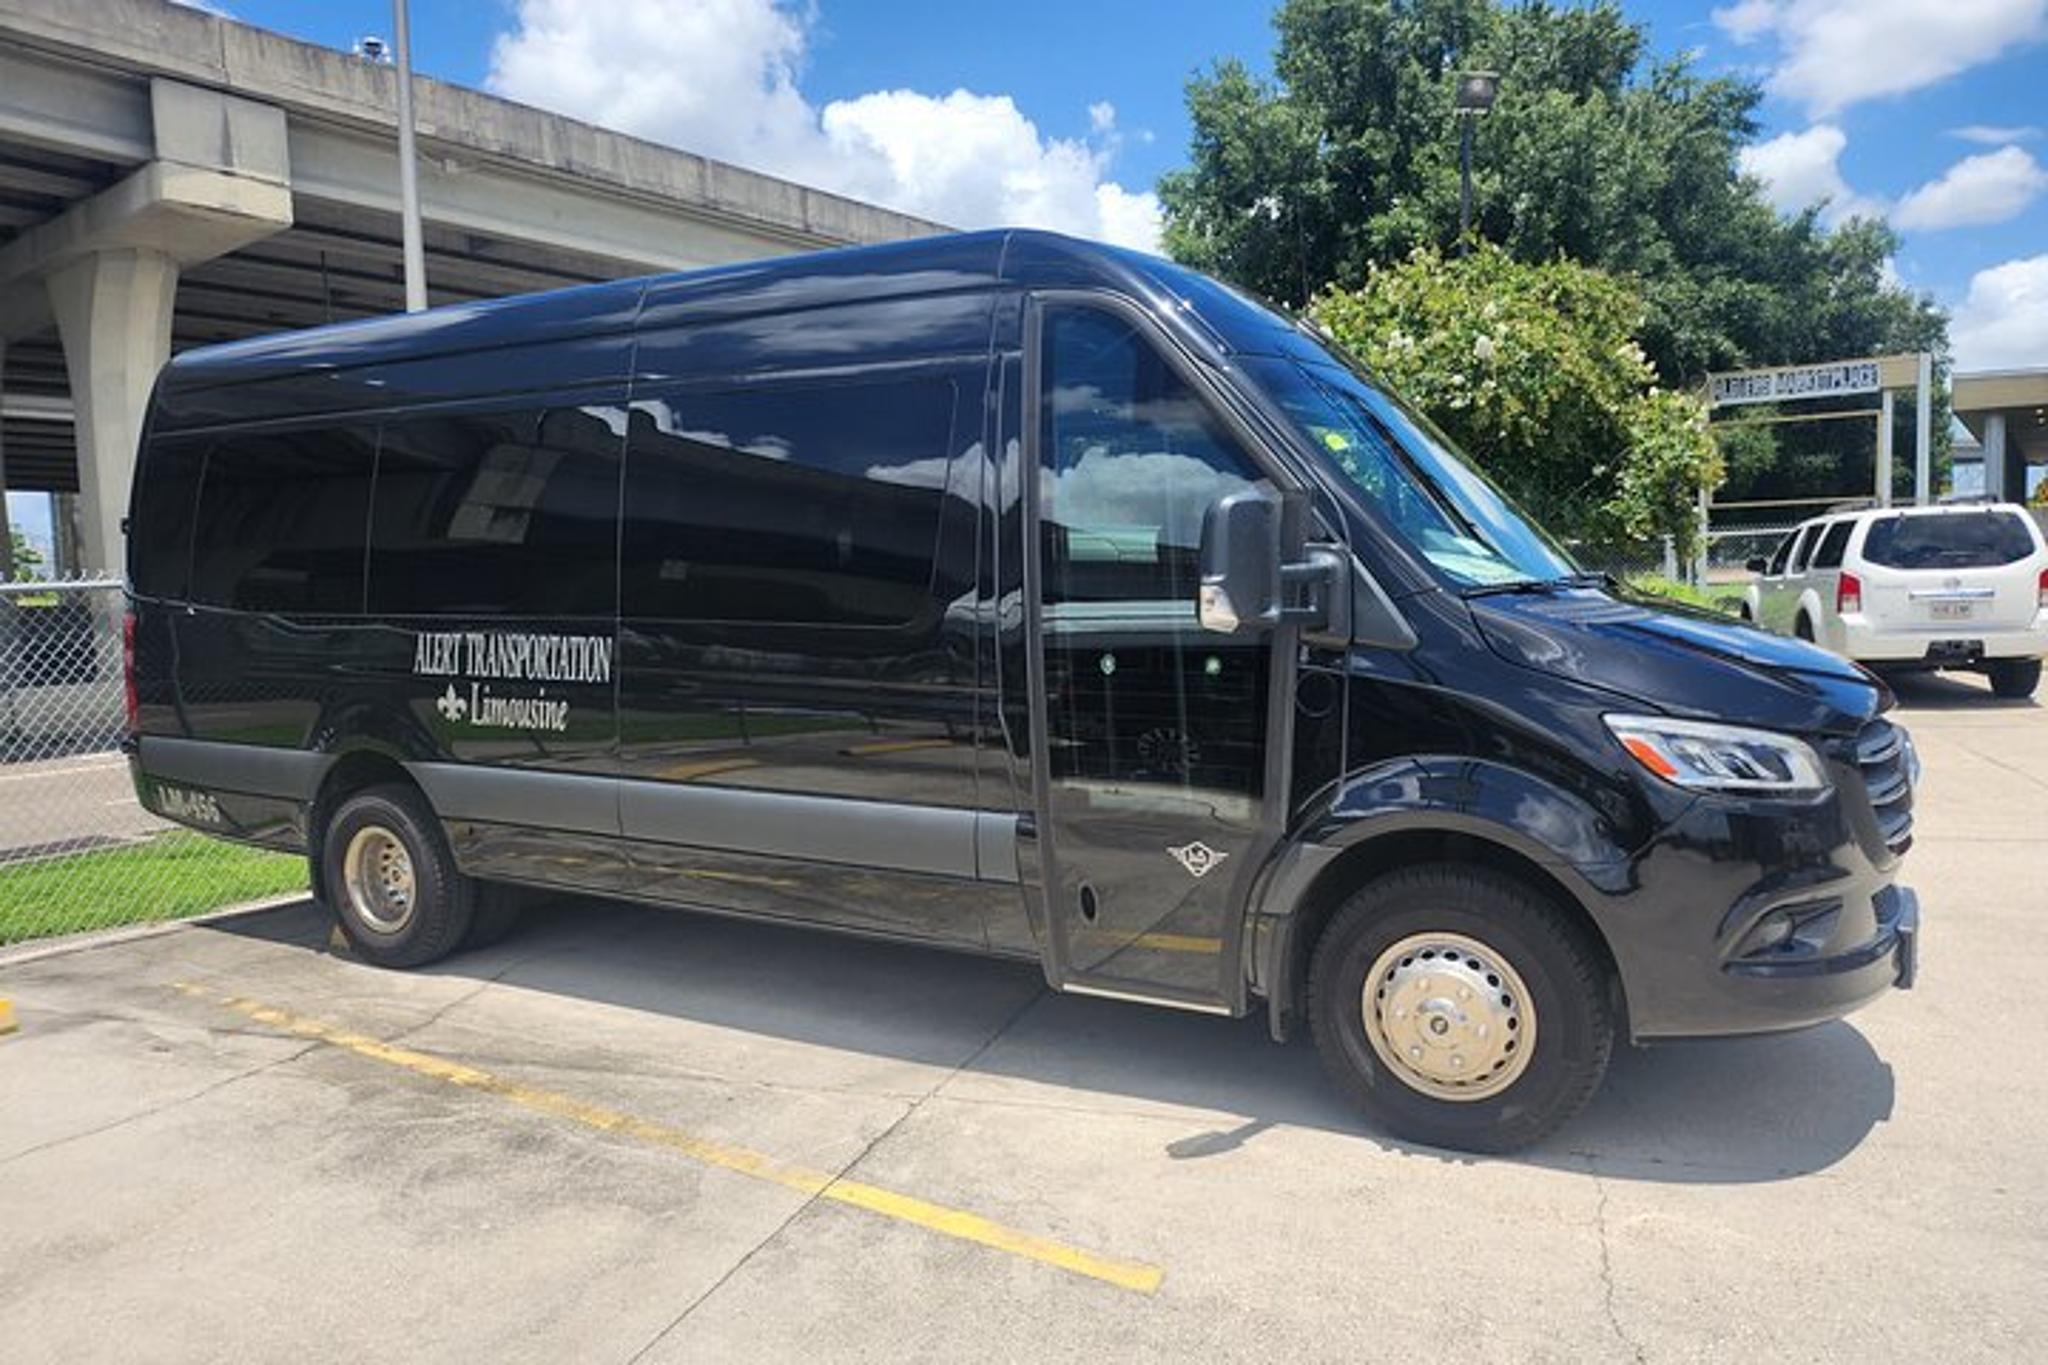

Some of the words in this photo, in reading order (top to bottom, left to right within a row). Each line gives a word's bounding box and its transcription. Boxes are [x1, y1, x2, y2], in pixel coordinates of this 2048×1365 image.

[413, 632, 462, 675] ALERT
[465, 633, 613, 683] TRANSPORTATION
[470, 681, 569, 732] Limousine
